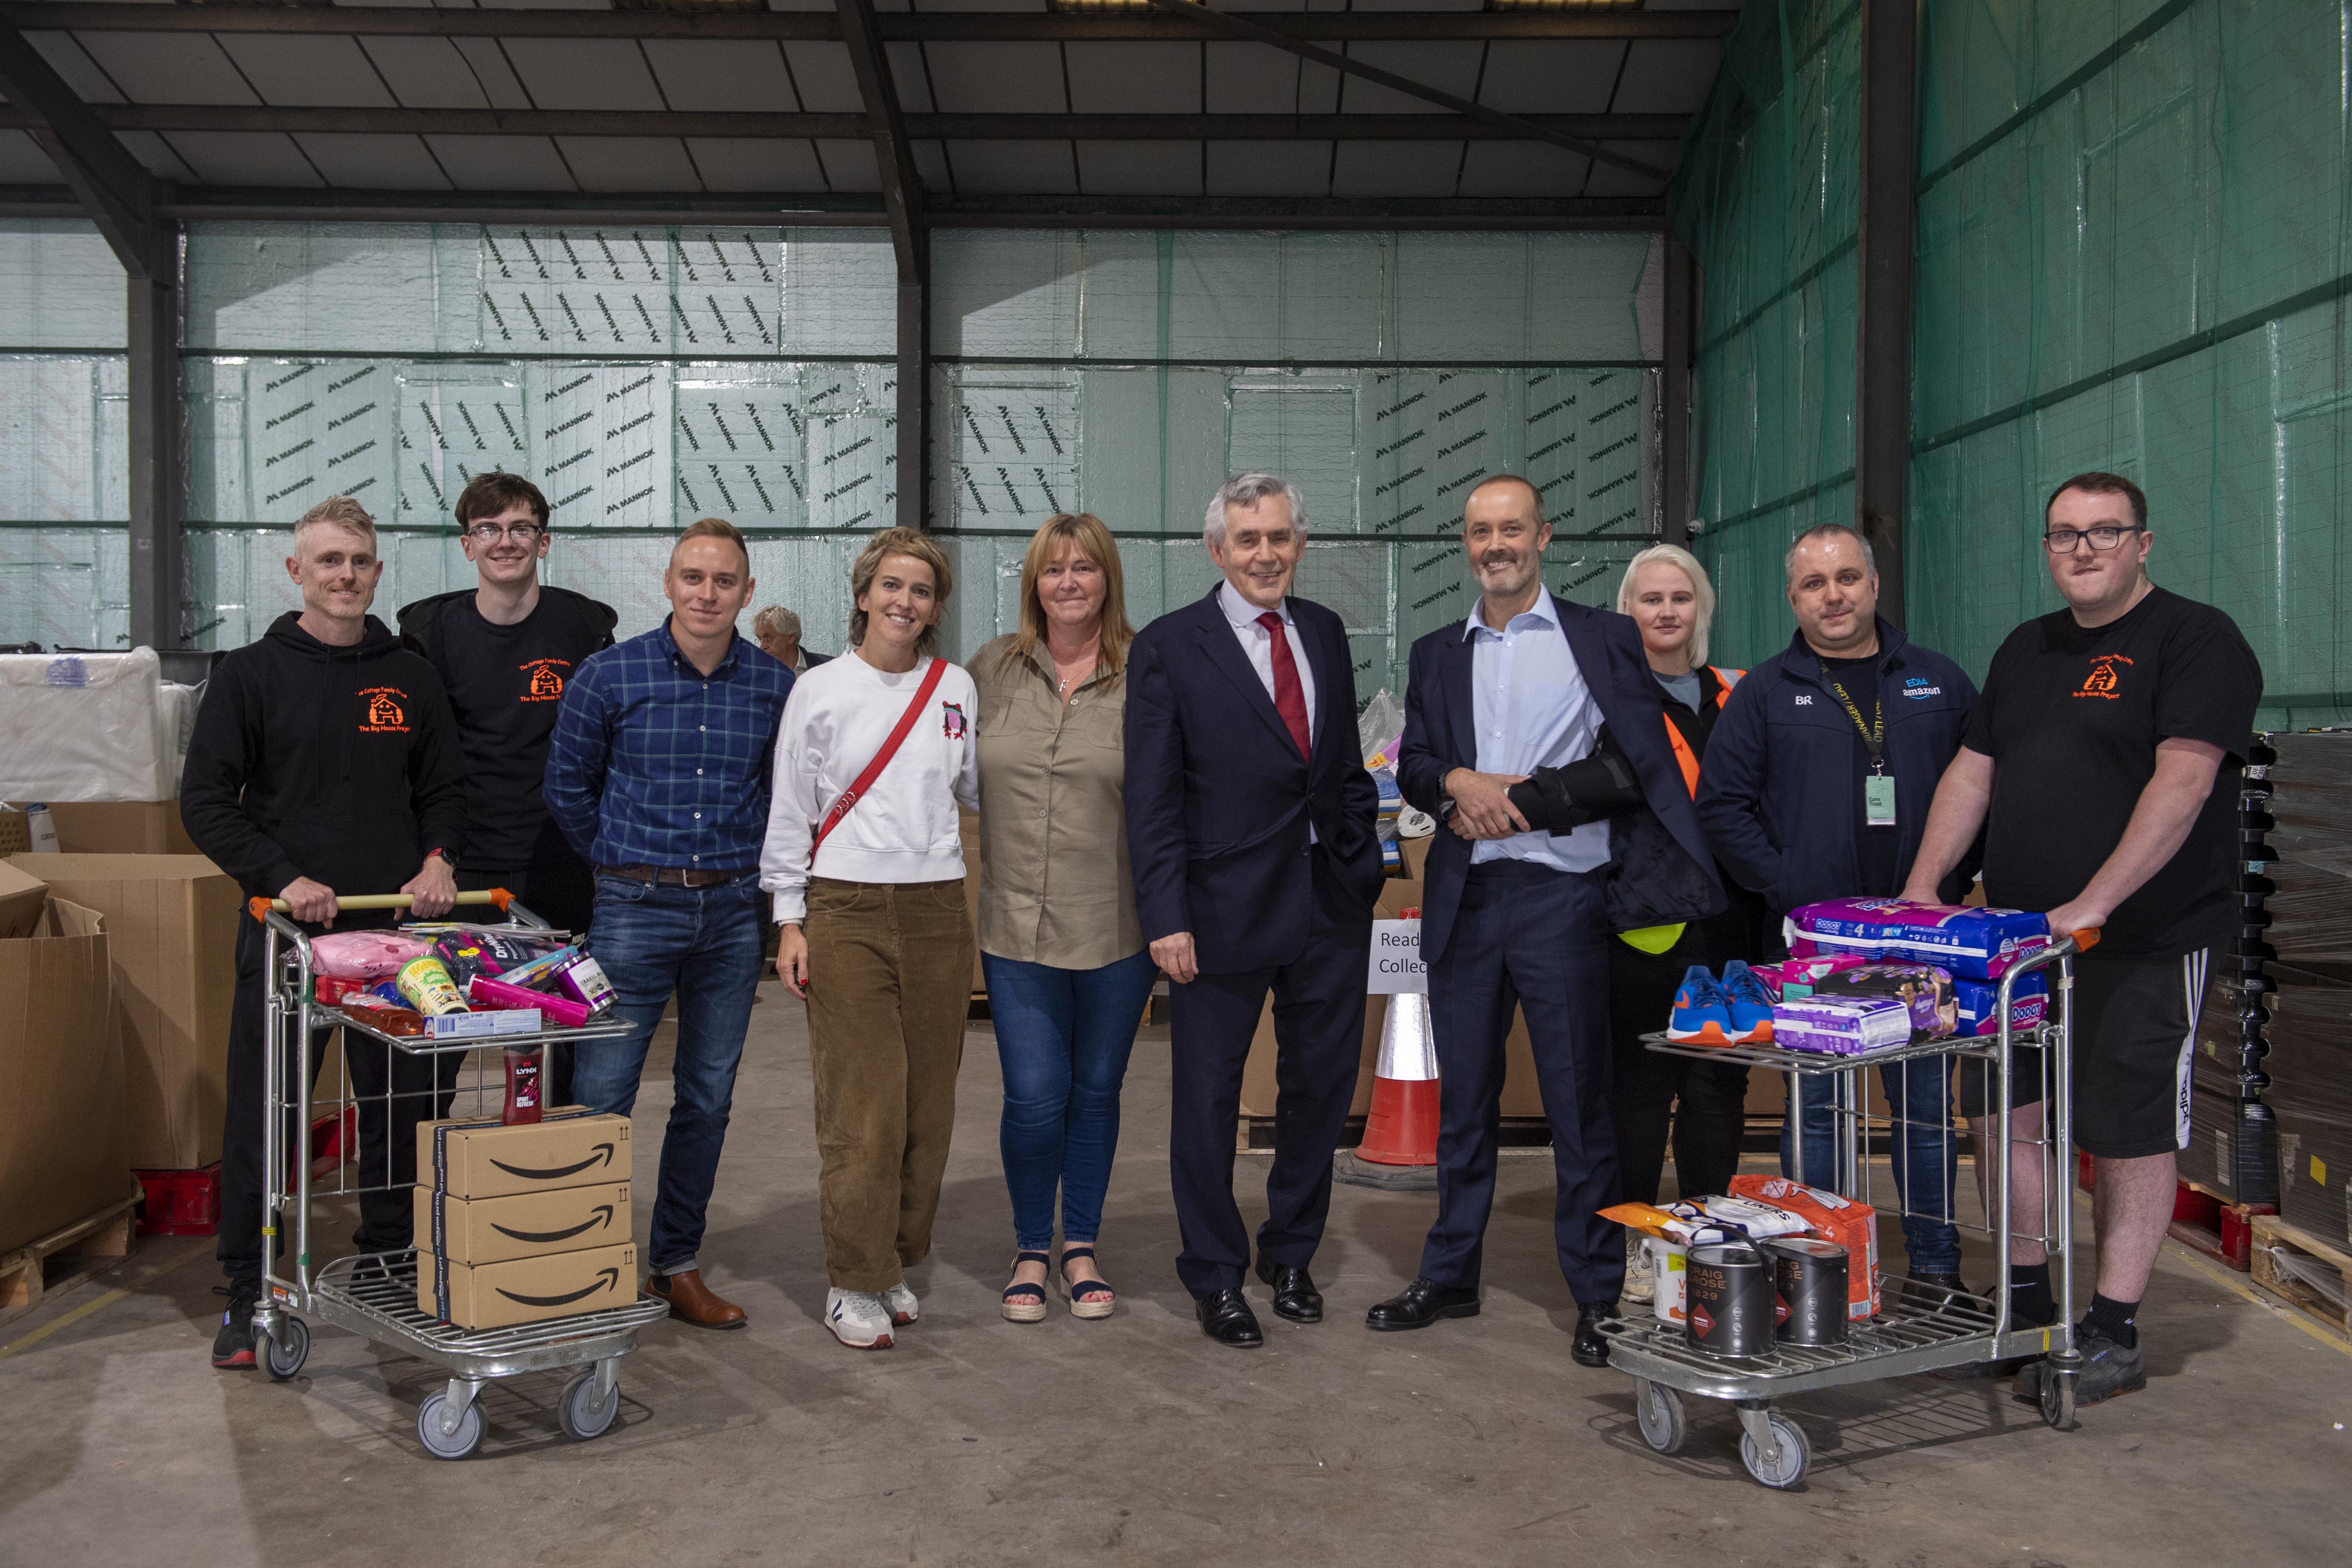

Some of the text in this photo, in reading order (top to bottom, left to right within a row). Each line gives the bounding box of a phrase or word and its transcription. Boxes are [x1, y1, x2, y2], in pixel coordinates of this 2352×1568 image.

[520, 230, 541, 266] MANNOK
[557, 230, 579, 266] MANNOK
[594, 230, 617, 267] MANNOK
[632, 231, 654, 268] MANNOK
[669, 232, 691, 268] MANNOK
[706, 232, 729, 268] MANNOK
[743, 233, 766, 269] MANNOK
[484, 291, 504, 327] MANNOK
[520, 291, 541, 328] MANNOK
[557, 292, 579, 329] MANNOK
[594, 293, 616, 329] MANNOK
[632, 293, 653, 330] MANNOK
[669, 293, 691, 330] MANNOK
[706, 295, 728, 331] MANNOK
[743, 295, 766, 332] MANNOK
[279, 364, 315, 385] MANNOK
[341, 366, 376, 386] MANNOK
[558, 373, 593, 395] MANNOK
[619, 373, 655, 396] MANNOK
[279, 401, 315, 422] MANNOK
[341, 403, 376, 423] MANNOK
[1389, 391, 1426, 414] MANNOK
[1451, 391, 1488, 414] MANNOK
[1526, 402, 1563, 425] MANNOK
[1588, 402, 1625, 425] MANNOK
[420, 400, 442, 436] MANNOK
[457, 401, 479, 437] MANNOK
[494, 401, 516, 437] MANNOK
[558, 410, 594, 432] MANNOK
[619, 411, 655, 433] MANNOK
[679, 415, 701, 452] MANNOK
[715, 415, 738, 452] MANNOK
[752, 416, 775, 452] MANNOK
[968, 418, 990, 454] MANNOK
[1005, 418, 1027, 455] MANNOK
[1042, 419, 1064, 456] MANNOK
[1389, 429, 1425, 451] MANNOK
[1450, 429, 1487, 452] MANNOK
[279, 439, 315, 459] MANNOK
[341, 440, 376, 461] MANNOK
[558, 447, 594, 470] MANNOK
[837, 436, 873, 458] MANNOK
[1526, 440, 1563, 463] MANNOK
[1587, 440, 1624, 463] MANNOK
[619, 448, 655, 471] MANNOK
[279, 476, 315, 497] MANNOK
[420, 462, 442, 498] MANNOK
[837, 473, 873, 495] MANNOK
[1388, 466, 1425, 489] MANNOK
[1450, 467, 1487, 489] MANNOK
[1587, 478, 1624, 500] MANNOK
[558, 485, 594, 507] MANNOK
[619, 485, 655, 508] MANNOK
[679, 477, 701, 513] MANNOK
[715, 477, 738, 514] MANNOK
[752, 478, 775, 514] MANNOK
[967, 480, 989, 516] MANNOK
[1003, 480, 1026, 516] MANNOK
[1388, 504, 1425, 526] MANNOK
[1411, 551, 1448, 574] MANNOK
[1573, 565, 1609, 587] MANNOK
[1411, 589, 1448, 611] MANNOK
[528, 659, 544, 667] Cottage
[1902, 686, 1941, 697] amazon
[1905, 677, 1929, 687] EDI4
[1795, 695, 1813, 705] BR
[1874, 721, 1884, 742] LEAD
[572, 933, 586, 945] NIKE
[1381, 932, 1420, 947] Read
[1854, 923, 1865, 938] 4
[1379, 958, 1427, 973] Collec
[2012, 1002, 2042, 1022] DODOT
[2179, 1071, 2190, 1125] adida
[1743, 1200, 1790, 1221] LINERS
[1824, 1226, 1834, 1239] 4
[1688, 1264, 1723, 1280] CRAIG
[1692, 1288, 1718, 1301] 1829
